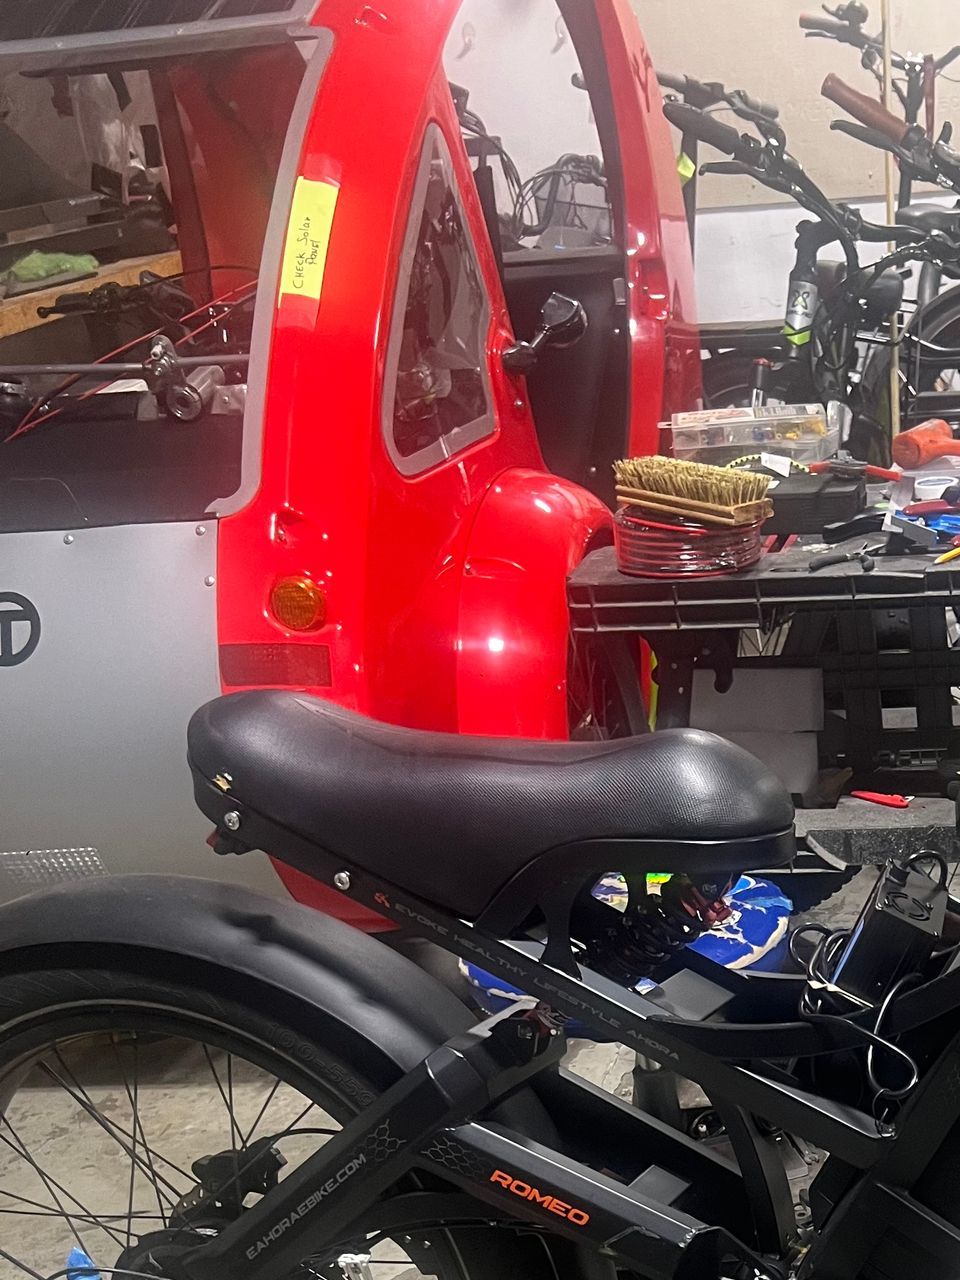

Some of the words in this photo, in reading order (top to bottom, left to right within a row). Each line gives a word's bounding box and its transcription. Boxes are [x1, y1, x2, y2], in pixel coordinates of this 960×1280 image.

[296, 216, 311, 246] Solar
[395, 902, 448, 936] EVOKE
[453, 934, 527, 977] HEALTHY
[533, 977, 621, 1029] LIFESTYLE
[246, 1153, 367, 1260] EAHORAEBIKE.COM
[490, 1169, 590, 1226] ROMEO
